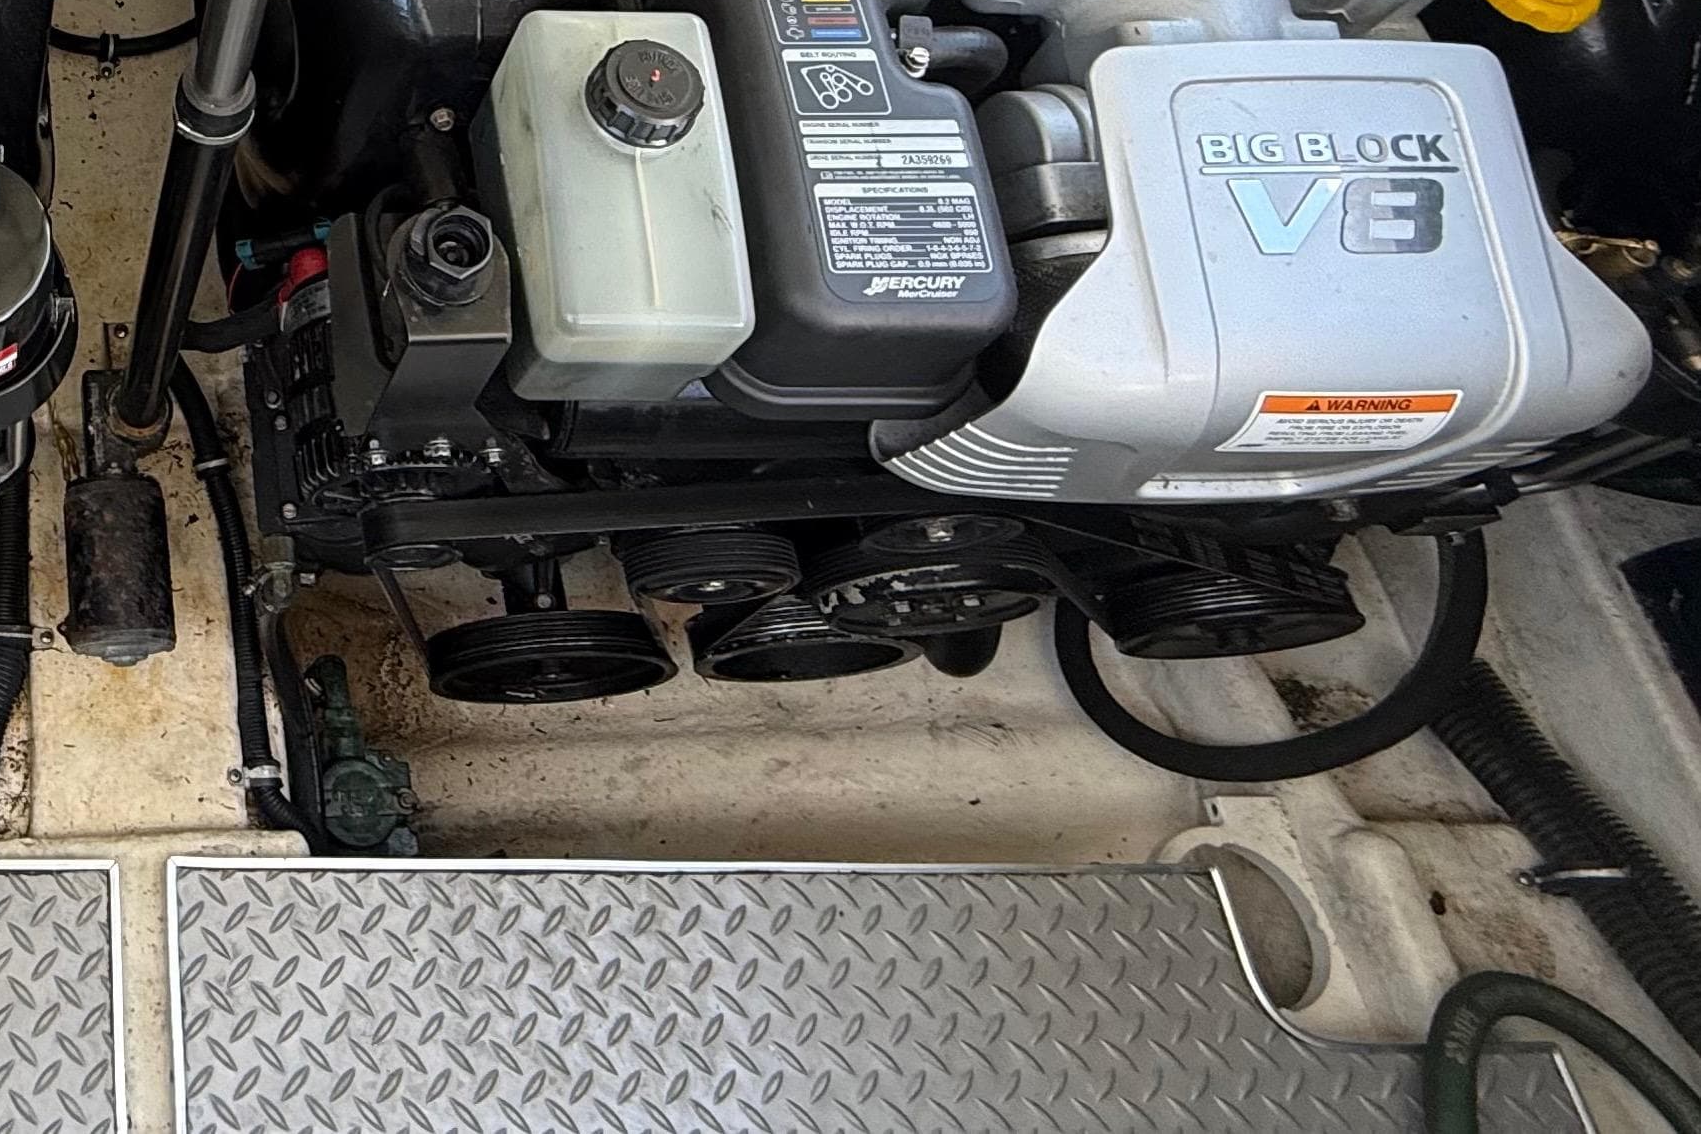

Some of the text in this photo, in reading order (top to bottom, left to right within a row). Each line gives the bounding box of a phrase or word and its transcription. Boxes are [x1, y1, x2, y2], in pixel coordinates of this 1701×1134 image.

[1198, 132, 1451, 165] BIG BLOCK
[1226, 178, 1445, 255] V8
[863, 276, 966, 295] MERCURY
[898, 290, 959, 298] MerCruiser
[1326, 399, 1412, 410] WARNING
